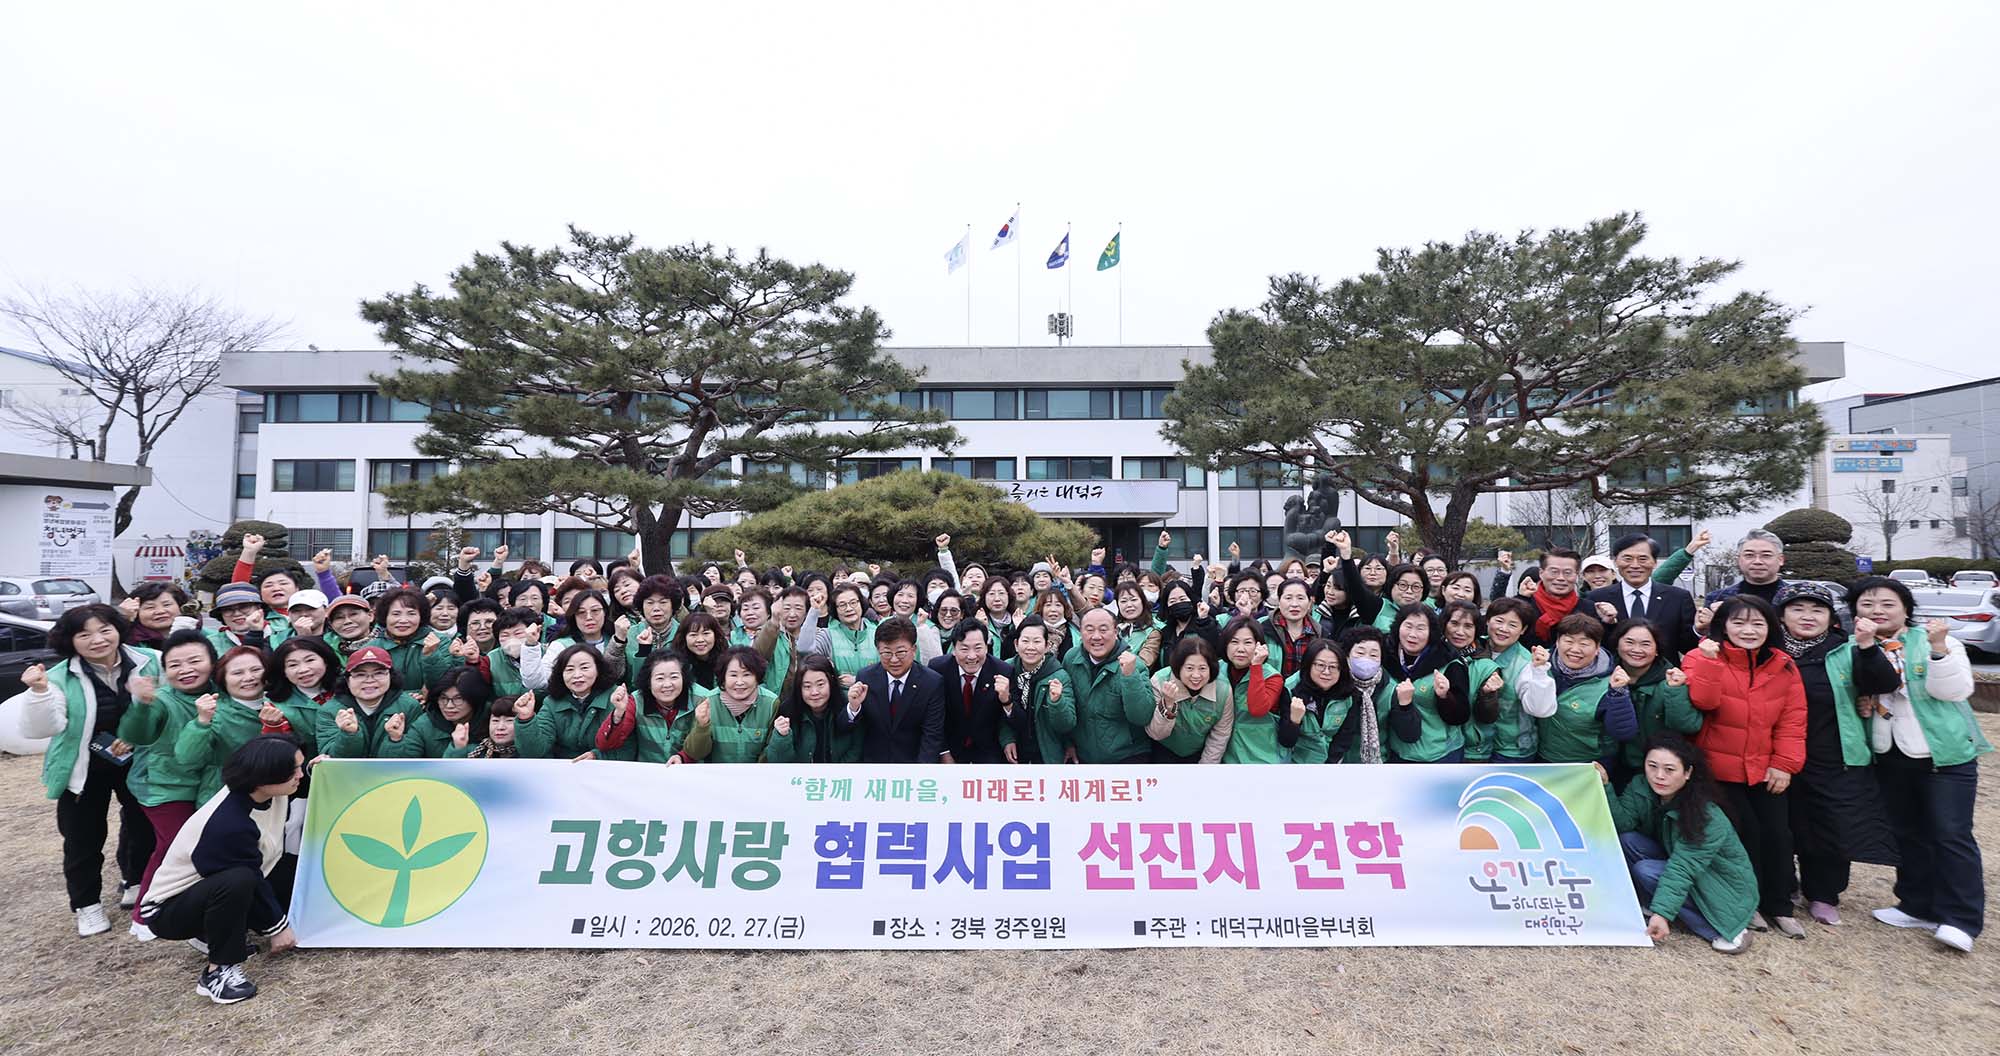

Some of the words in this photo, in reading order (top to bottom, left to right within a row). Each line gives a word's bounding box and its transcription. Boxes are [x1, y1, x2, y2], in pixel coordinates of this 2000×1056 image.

[1055, 484, 1103, 500] 대덕구
[864, 778, 948, 805] 새마을,
[962, 778, 1045, 803] 미래로!
[538, 819, 790, 890] 고향사랑
[813, 820, 1052, 890] 협력사업
[1077, 822, 1261, 890] 선진지
[1283, 821, 1407, 890] 견학
[1469, 861, 1591, 910] 온기나눔
[1512, 896, 1567, 914] 하나되는
[589, 915, 627, 938] 일시
[649, 917, 700, 938] 2026.
[708, 917, 736, 938] 02.
[889, 916, 926, 940] 장소
[950, 916, 987, 940] 경북
[994, 916, 1066, 940] 경주일원
[1150, 916, 1187, 940] 주관
[1211, 916, 1376, 939] 대덕구새마을부녀회
[1525, 915, 1584, 935] 대한민국
